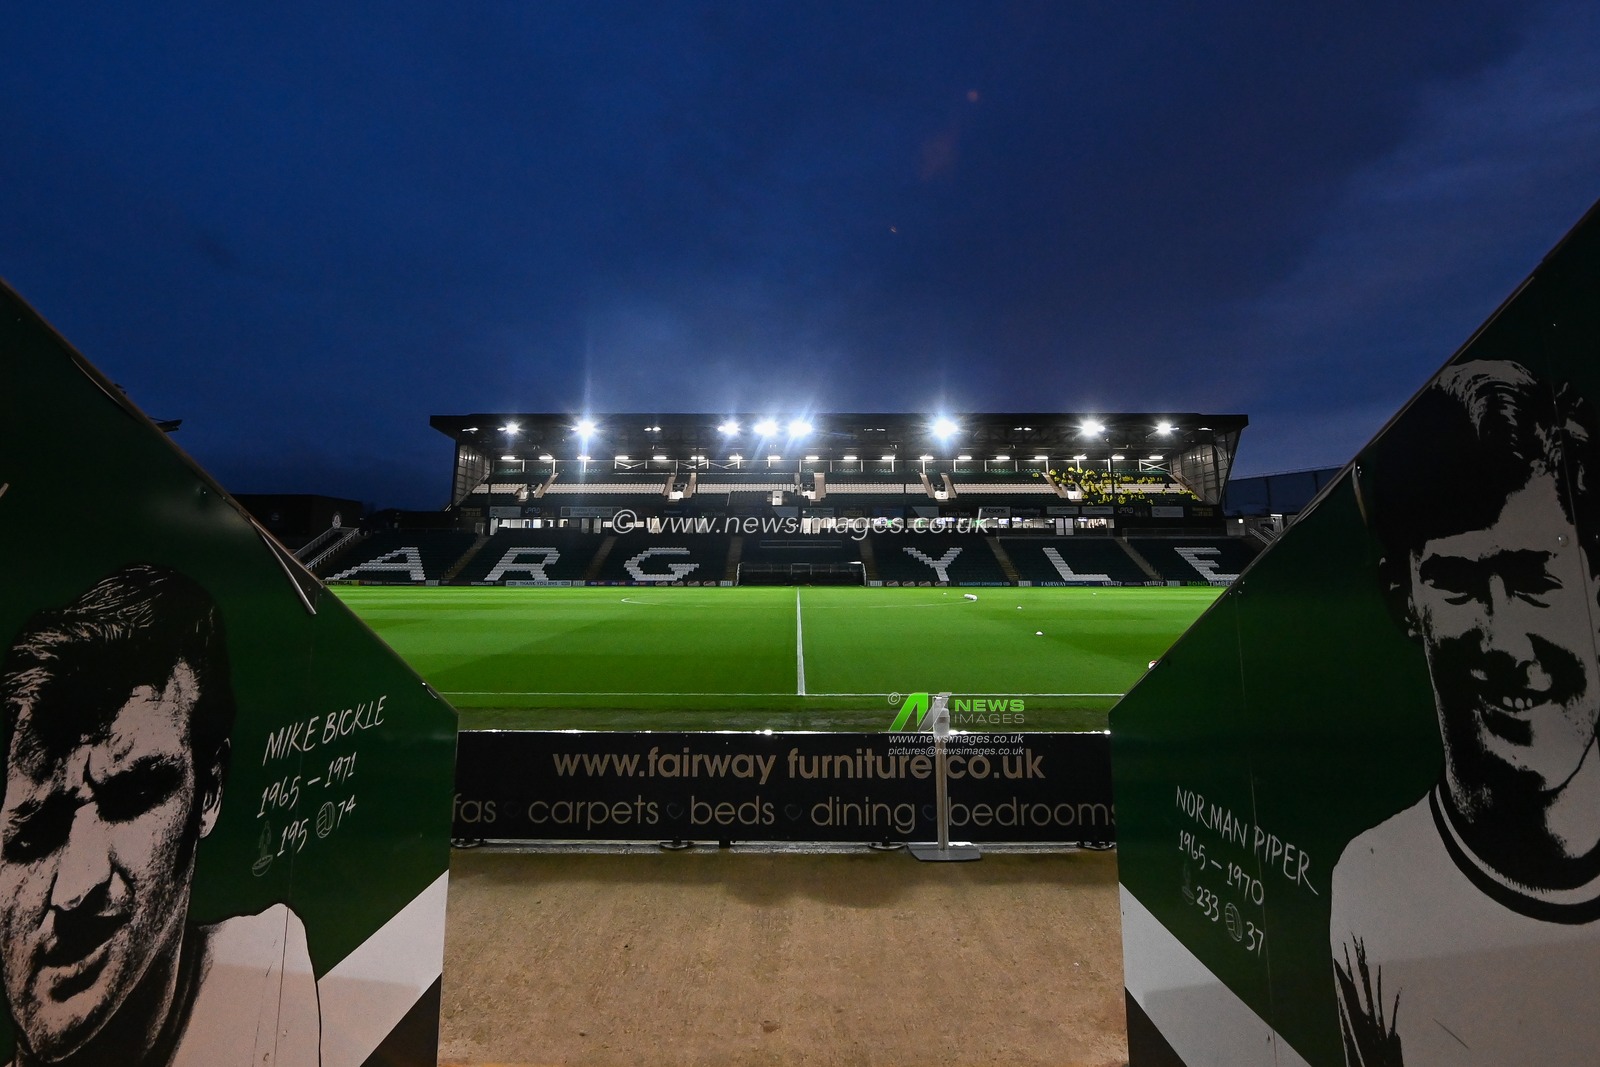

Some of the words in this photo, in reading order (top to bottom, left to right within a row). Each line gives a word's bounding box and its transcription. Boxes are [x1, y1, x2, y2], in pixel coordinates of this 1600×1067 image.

[262, 715, 319, 766] MIKE
[322, 695, 387, 744] BICKLE
[257, 776, 301, 818] 1965
[324, 752, 357, 788] 1971
[553, 747, 776, 785] www.fairway
[277, 818, 309, 857] 195
[337, 794, 356, 830] 74
[528, 794, 659, 831] carpets
[690, 795, 775, 825] beds
[811, 796, 916, 834] dining
[1176, 785, 1248, 849] NORMAN
[1254, 825, 1319, 896] PIPER
[1178, 829, 1206, 870] 1965
[1226, 862, 1264, 905] 1970
[1196, 885, 1220, 922] 233
[1246, 921, 1264, 957] 37
